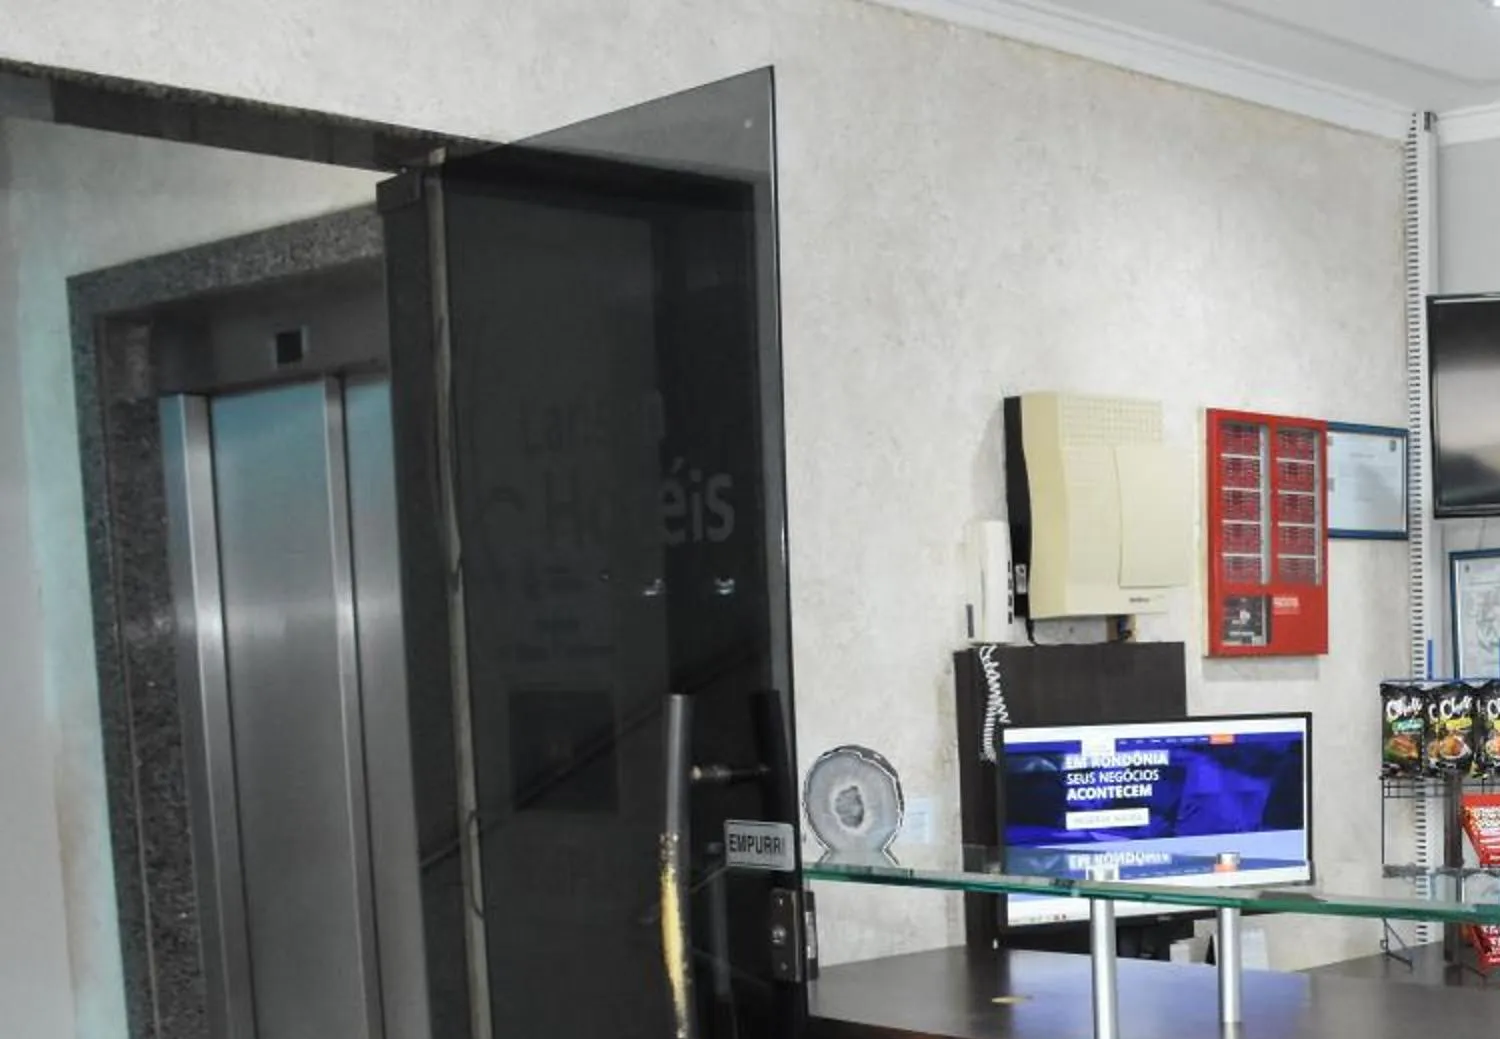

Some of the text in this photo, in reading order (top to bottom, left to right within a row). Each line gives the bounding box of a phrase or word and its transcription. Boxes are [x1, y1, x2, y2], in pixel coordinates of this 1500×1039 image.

[1066, 768, 1159, 785] SEUS NEGÓCIOS
[1066, 784, 1153, 801] ACONTECEM
